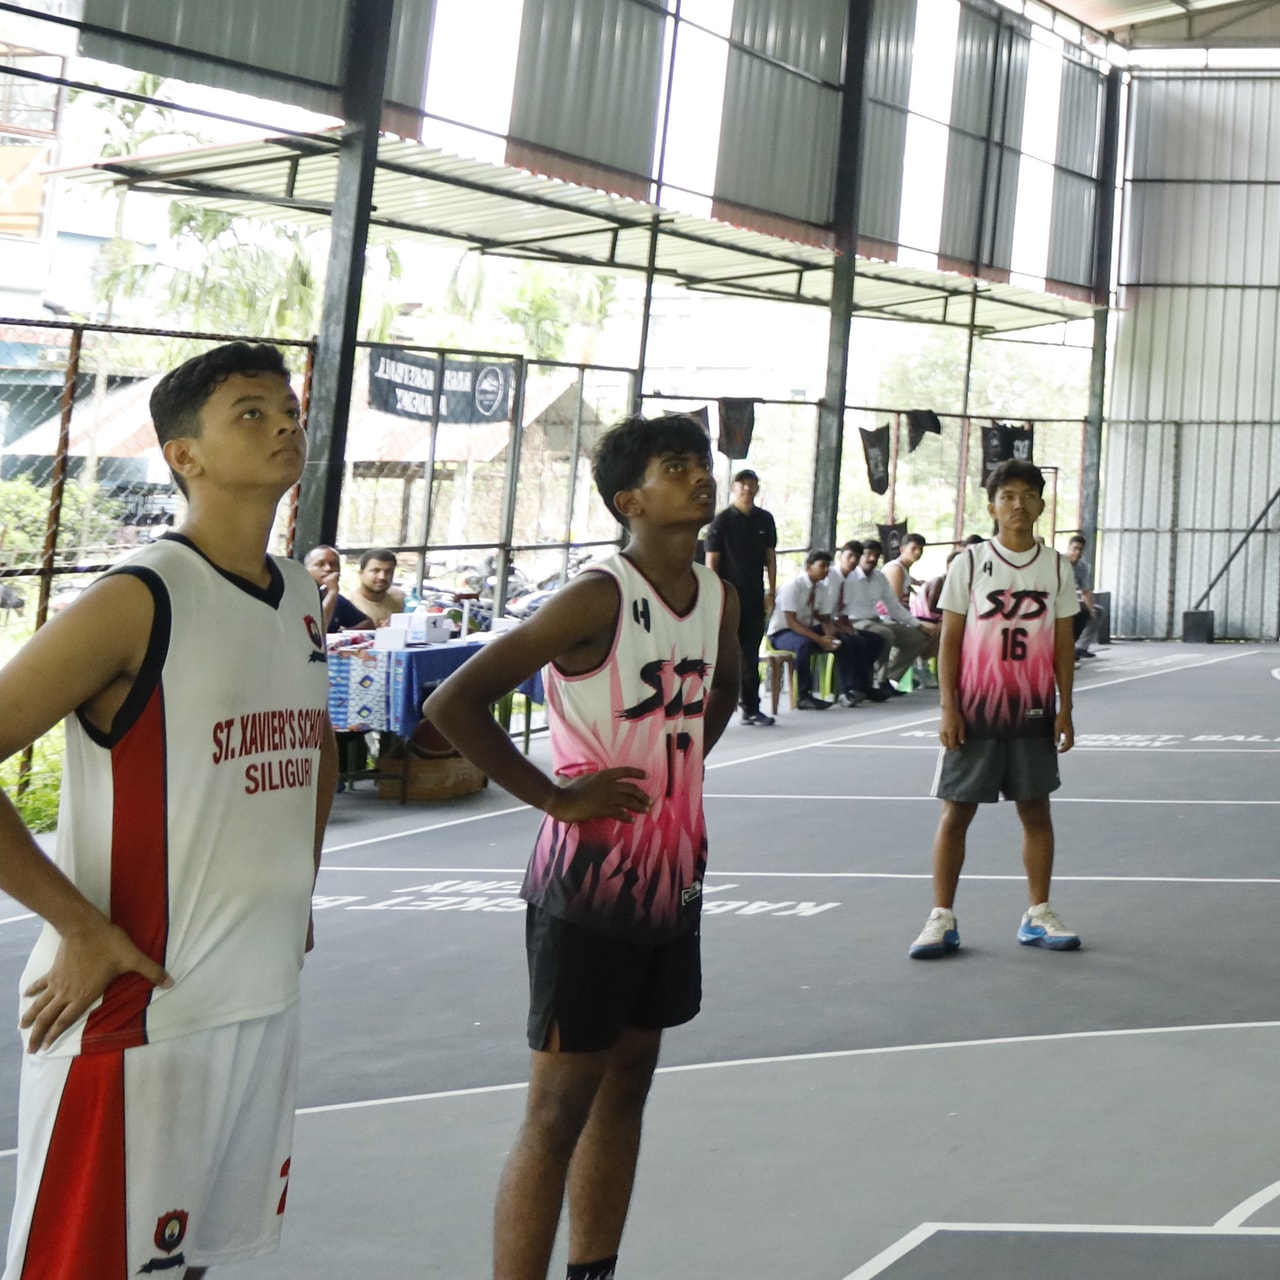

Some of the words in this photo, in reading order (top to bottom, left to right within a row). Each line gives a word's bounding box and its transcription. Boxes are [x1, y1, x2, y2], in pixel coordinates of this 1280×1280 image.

[1001, 627, 1029, 661] 16
[212, 718, 236, 765] ST.
[239, 708, 296, 758] XAVIER'S
